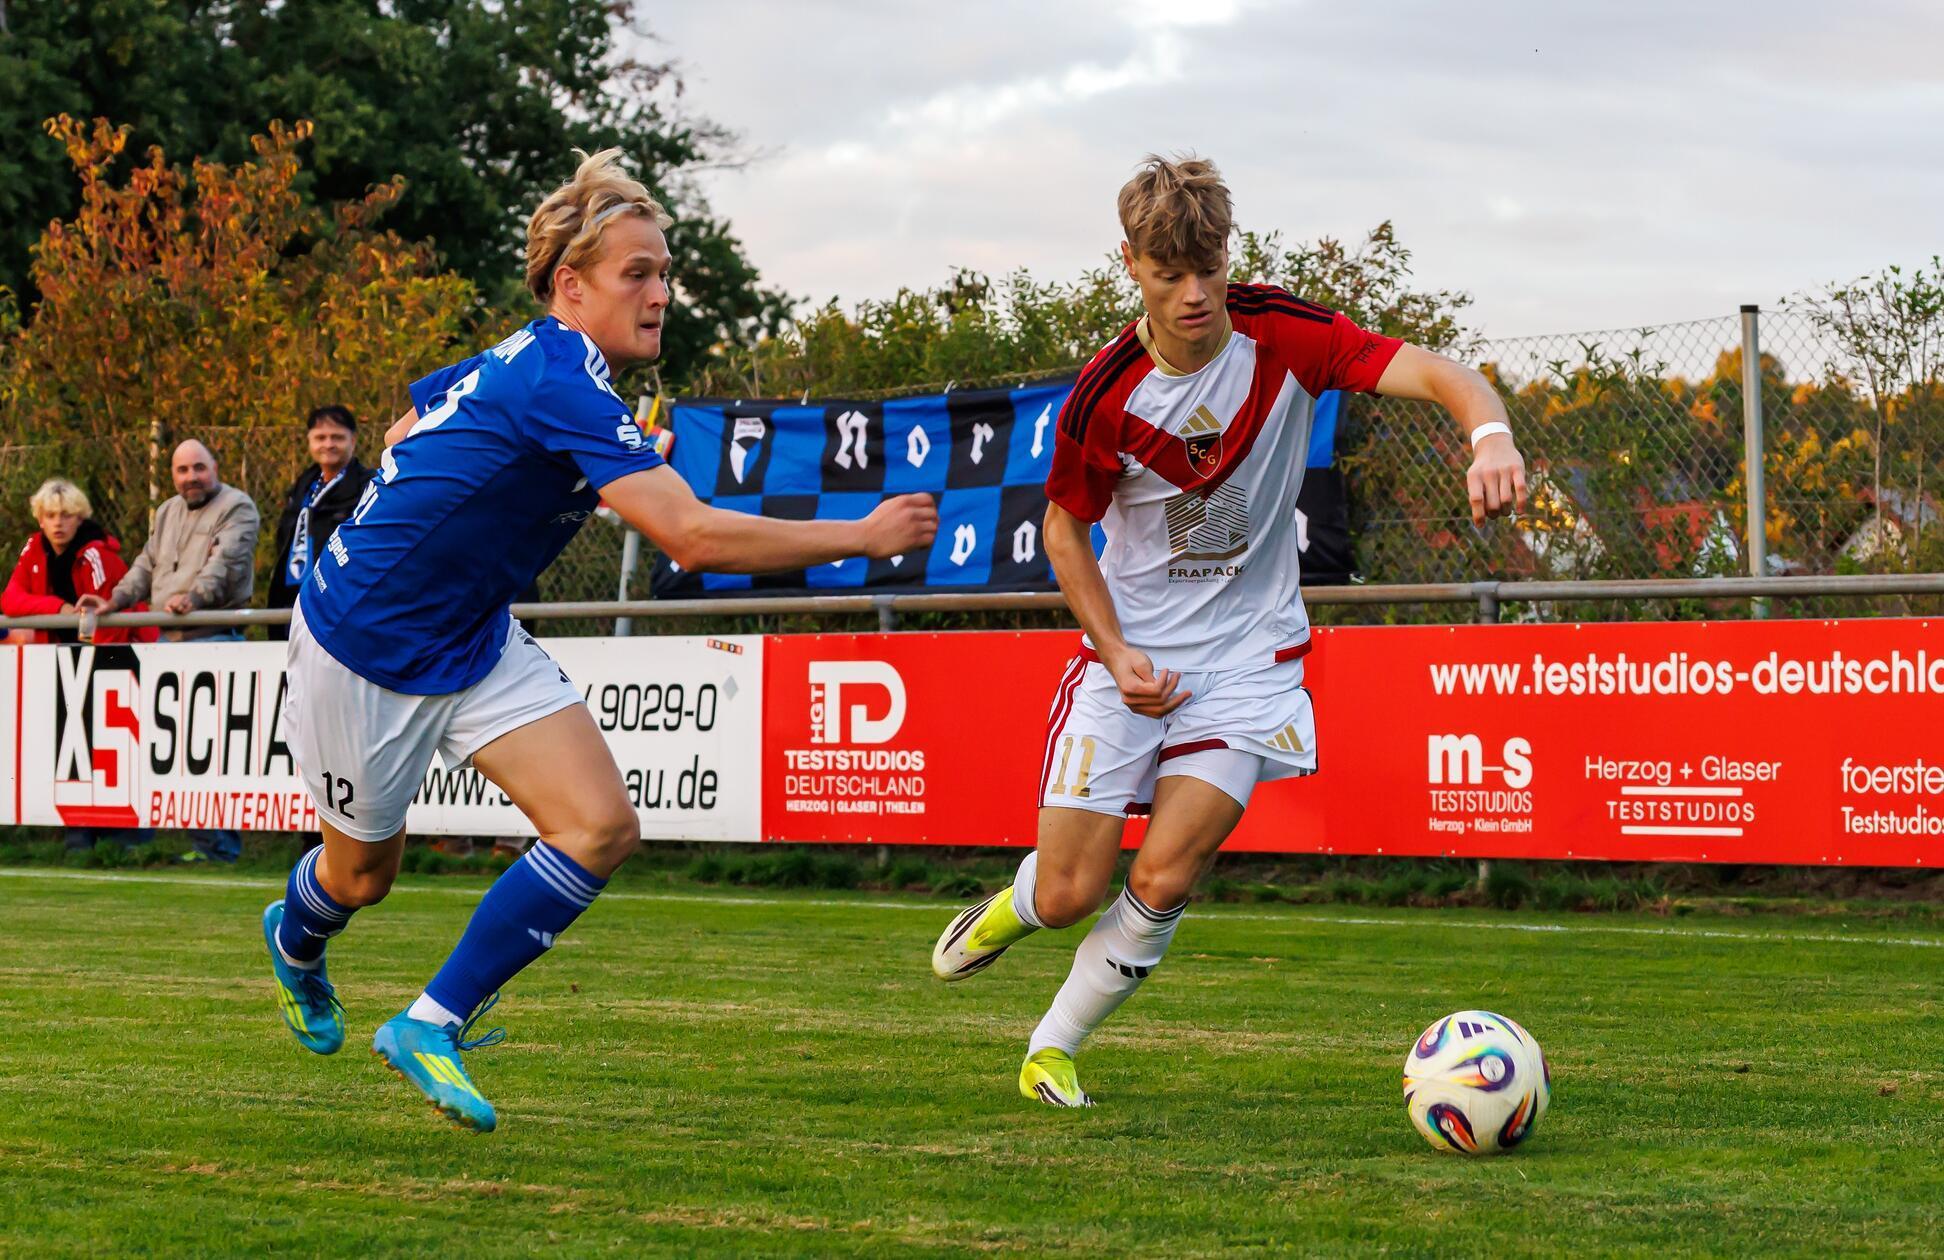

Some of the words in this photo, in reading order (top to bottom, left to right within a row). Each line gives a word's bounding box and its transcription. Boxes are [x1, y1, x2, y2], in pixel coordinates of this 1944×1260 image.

[1189, 443, 1216, 465] SCG
[1168, 565, 1245, 578] FRAPACK
[600, 683, 718, 731] 9029-0
[810, 685, 824, 744] HGT
[150, 671, 295, 776] SCHA
[784, 750, 926, 771] TESTSTUDIOS
[1051, 735, 1096, 798] 11
[1585, 755, 1672, 786] Herzog
[1701, 756, 1782, 781] Glaser
[322, 771, 355, 820] 12
[785, 775, 926, 796] DEUTSCHLAND
[150, 791, 316, 831] BAUUNTERNEH
[786, 800, 830, 813] HERZOG
[836, 801, 878, 814] GLASER
[885, 802, 926, 814] THELEN
[1429, 790, 1533, 813] TESTSTUDIOS
[1606, 801, 1755, 822] TESTSTUDIOS
[1429, 817, 1465, 835] Herzog
[1474, 817, 1500, 832] Klein
[1501, 818, 1533, 833] GmbH
